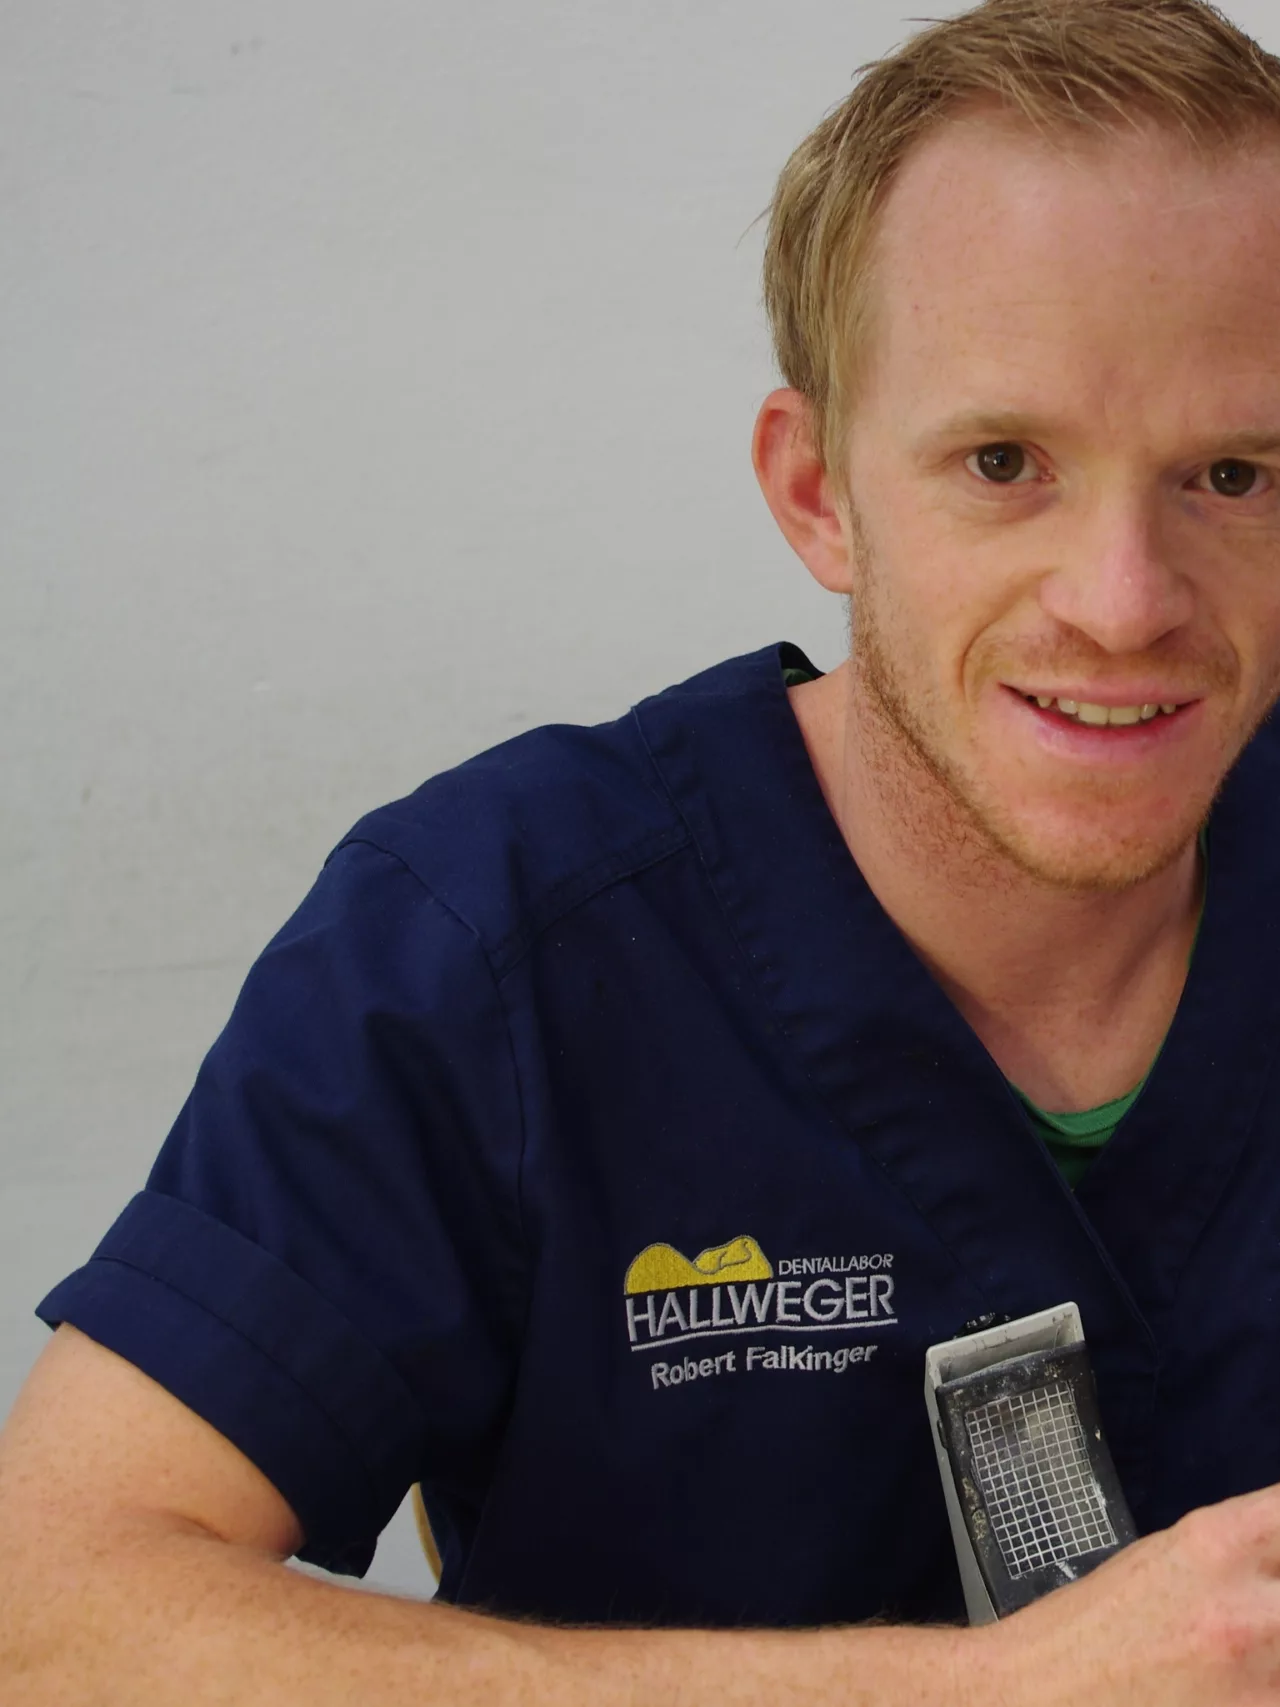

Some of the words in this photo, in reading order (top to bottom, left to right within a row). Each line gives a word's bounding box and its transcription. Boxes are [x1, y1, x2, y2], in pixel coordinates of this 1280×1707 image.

[779, 1254, 893, 1275] DENTALLABOR
[626, 1275, 895, 1341] HALLWEGER
[651, 1351, 736, 1390] Robert
[747, 1345, 878, 1372] Falkinger
